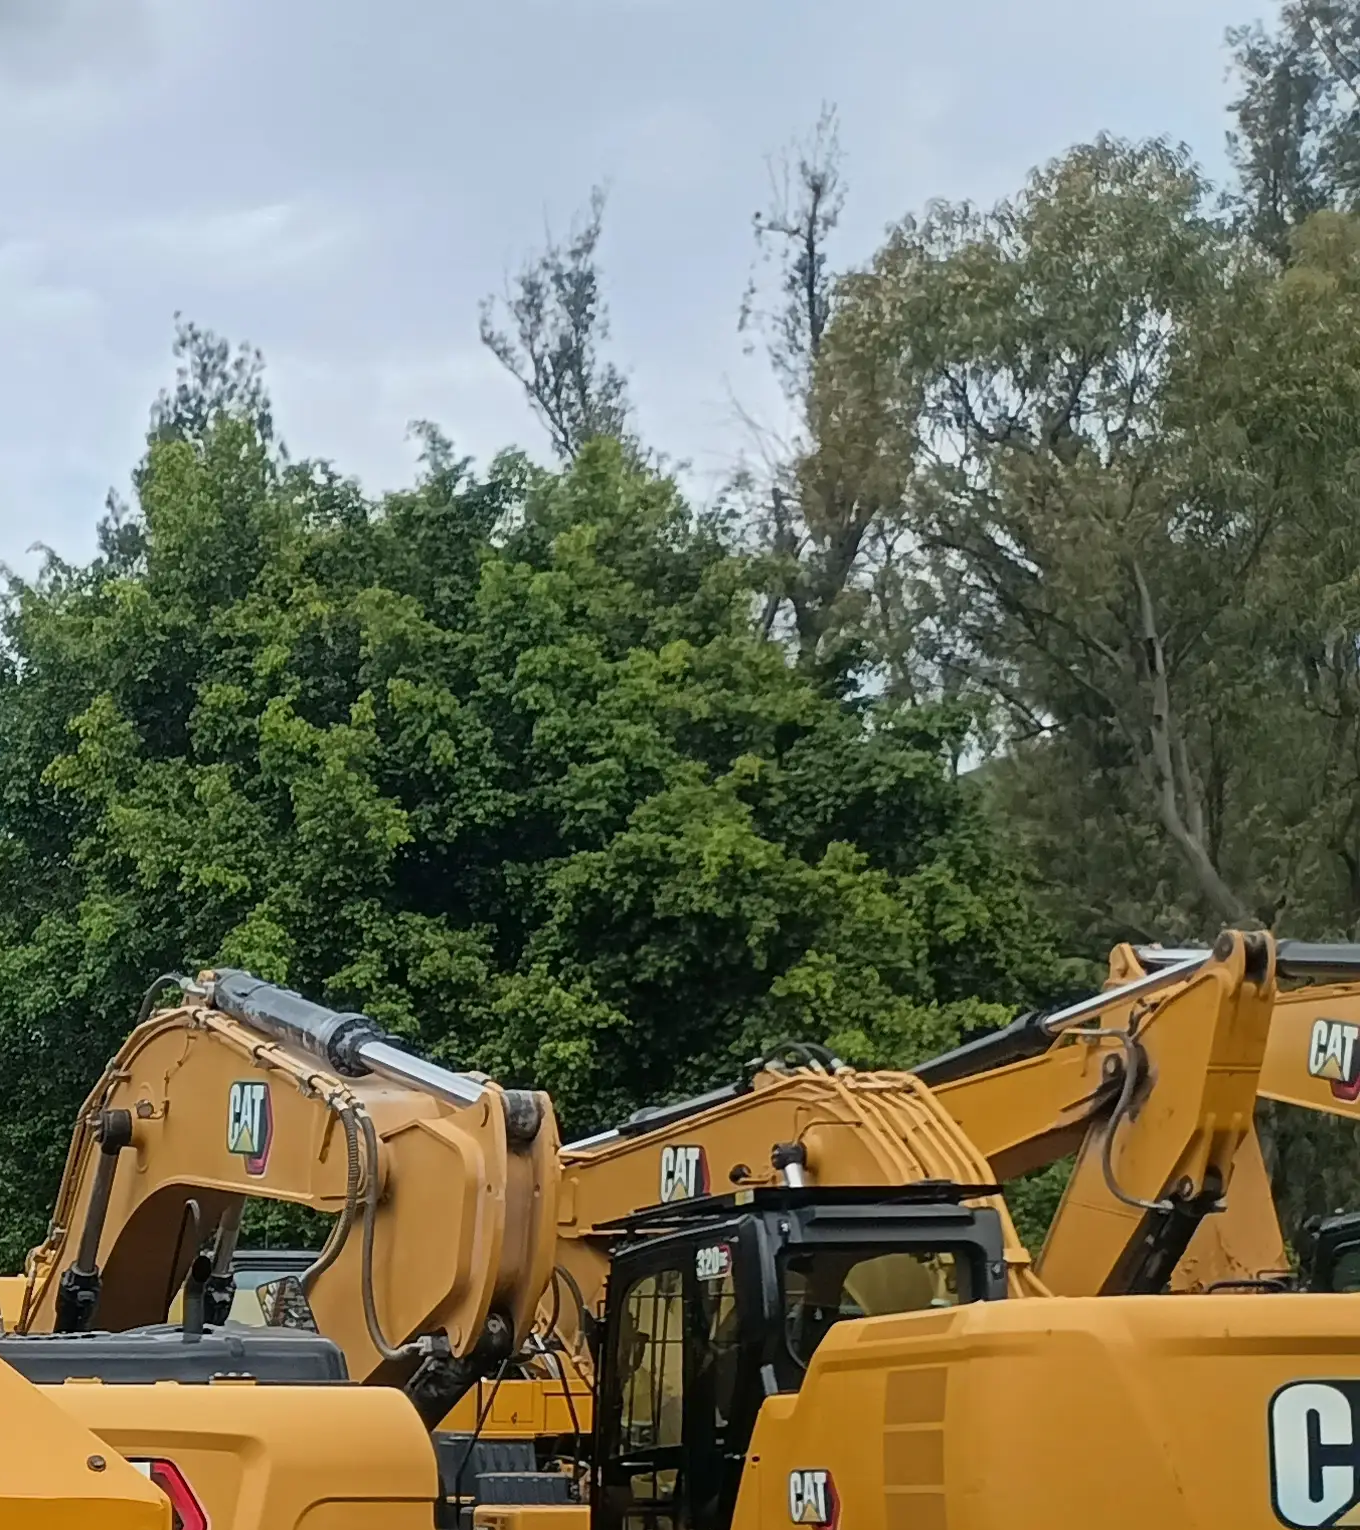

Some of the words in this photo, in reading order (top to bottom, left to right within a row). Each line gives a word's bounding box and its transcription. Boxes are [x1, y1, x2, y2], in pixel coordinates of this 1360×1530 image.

[1309, 1020, 1359, 1081] CAT
[227, 1083, 265, 1153] CAT
[661, 1147, 700, 1203] CAT
[790, 1471, 827, 1523] CAT
